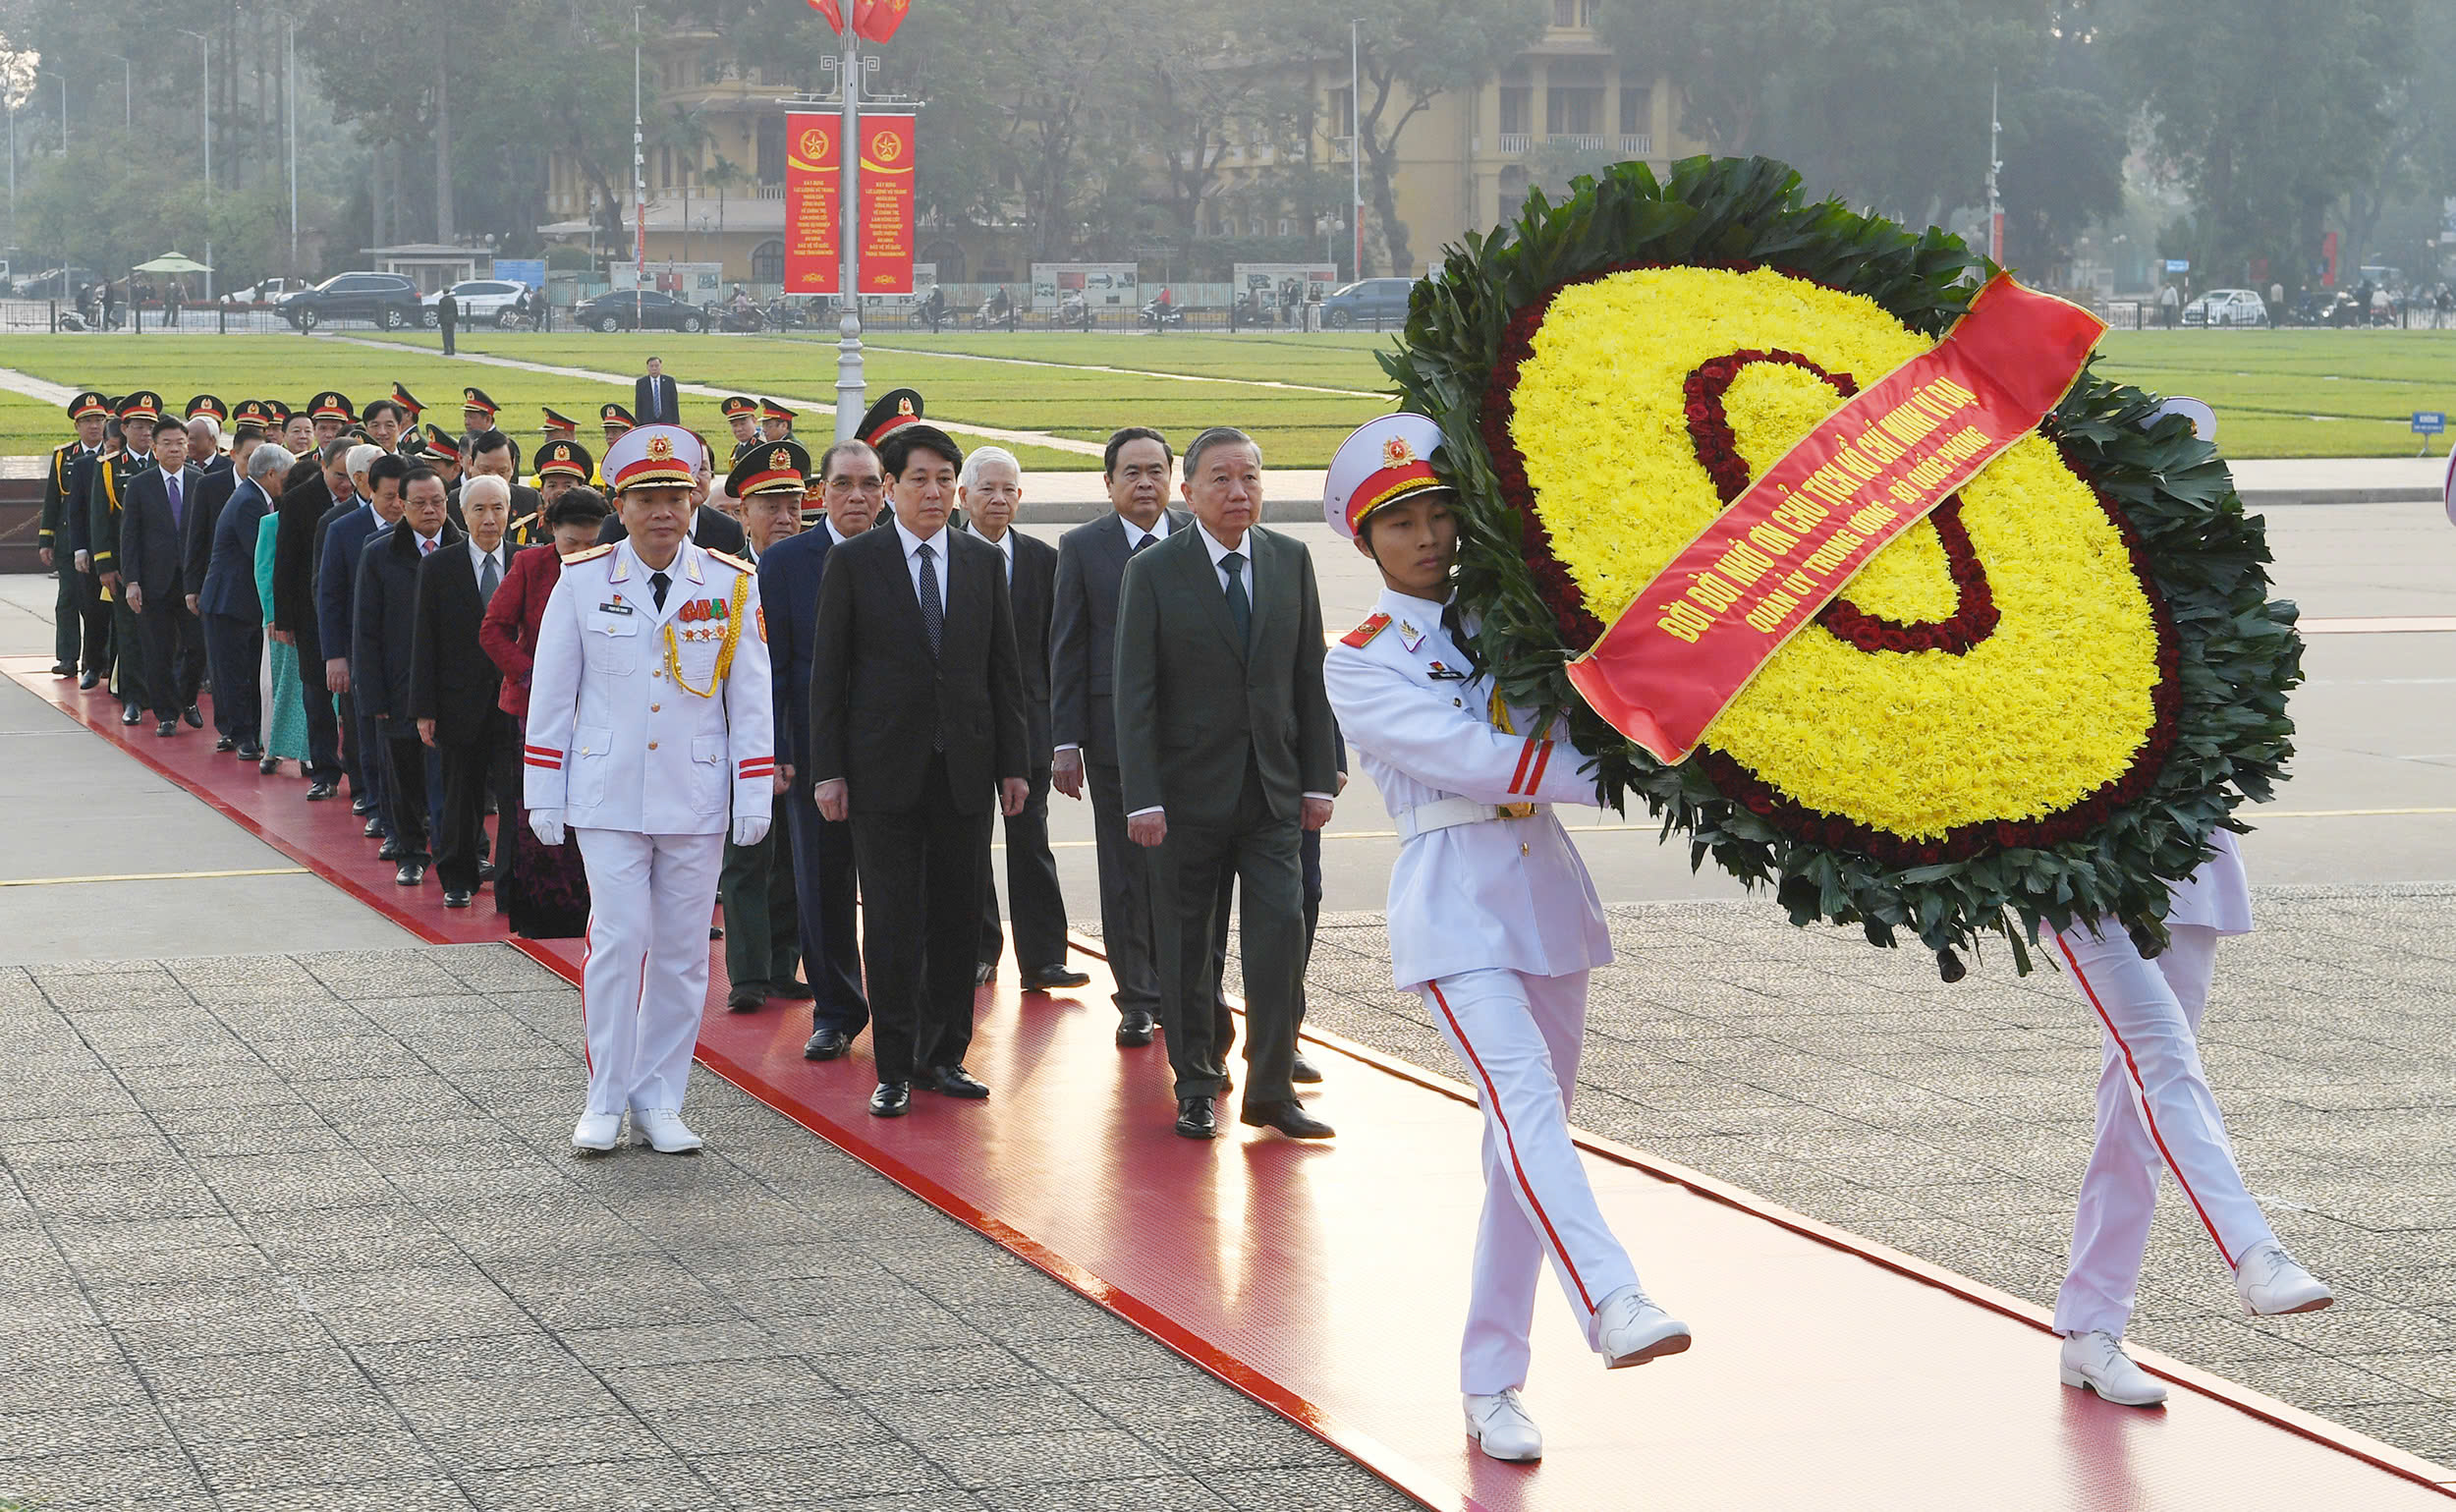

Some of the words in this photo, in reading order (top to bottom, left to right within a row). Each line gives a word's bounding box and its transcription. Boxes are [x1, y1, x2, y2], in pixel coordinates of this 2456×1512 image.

[1911, 386, 1955, 420] VĨ
[1926, 376, 1979, 409] ĐẠI
[1857, 419, 1907, 464] CHÍ
[1878, 402, 1941, 447] MINH
[1834, 433, 1882, 480] HỒ
[1802, 463, 1863, 504] TỊCH
[1746, 588, 1800, 633] QUÂN
[1774, 569, 1818, 595] ỦY
[1802, 529, 1864, 576] TRUNG
[1847, 500, 1898, 535] ƯƠNG
[1888, 476, 1926, 505] BỘ
[1907, 452, 1953, 489] QUỐC
[1936, 424, 1991, 467] PHÒNG
[1770, 483, 1829, 533] CHỦ
[1749, 521, 1800, 555] ƠN
[1713, 538, 1775, 588] NHỚ
[1686, 572, 1744, 613] ĐỜI
[1657, 599, 1716, 644] ĐỜI
